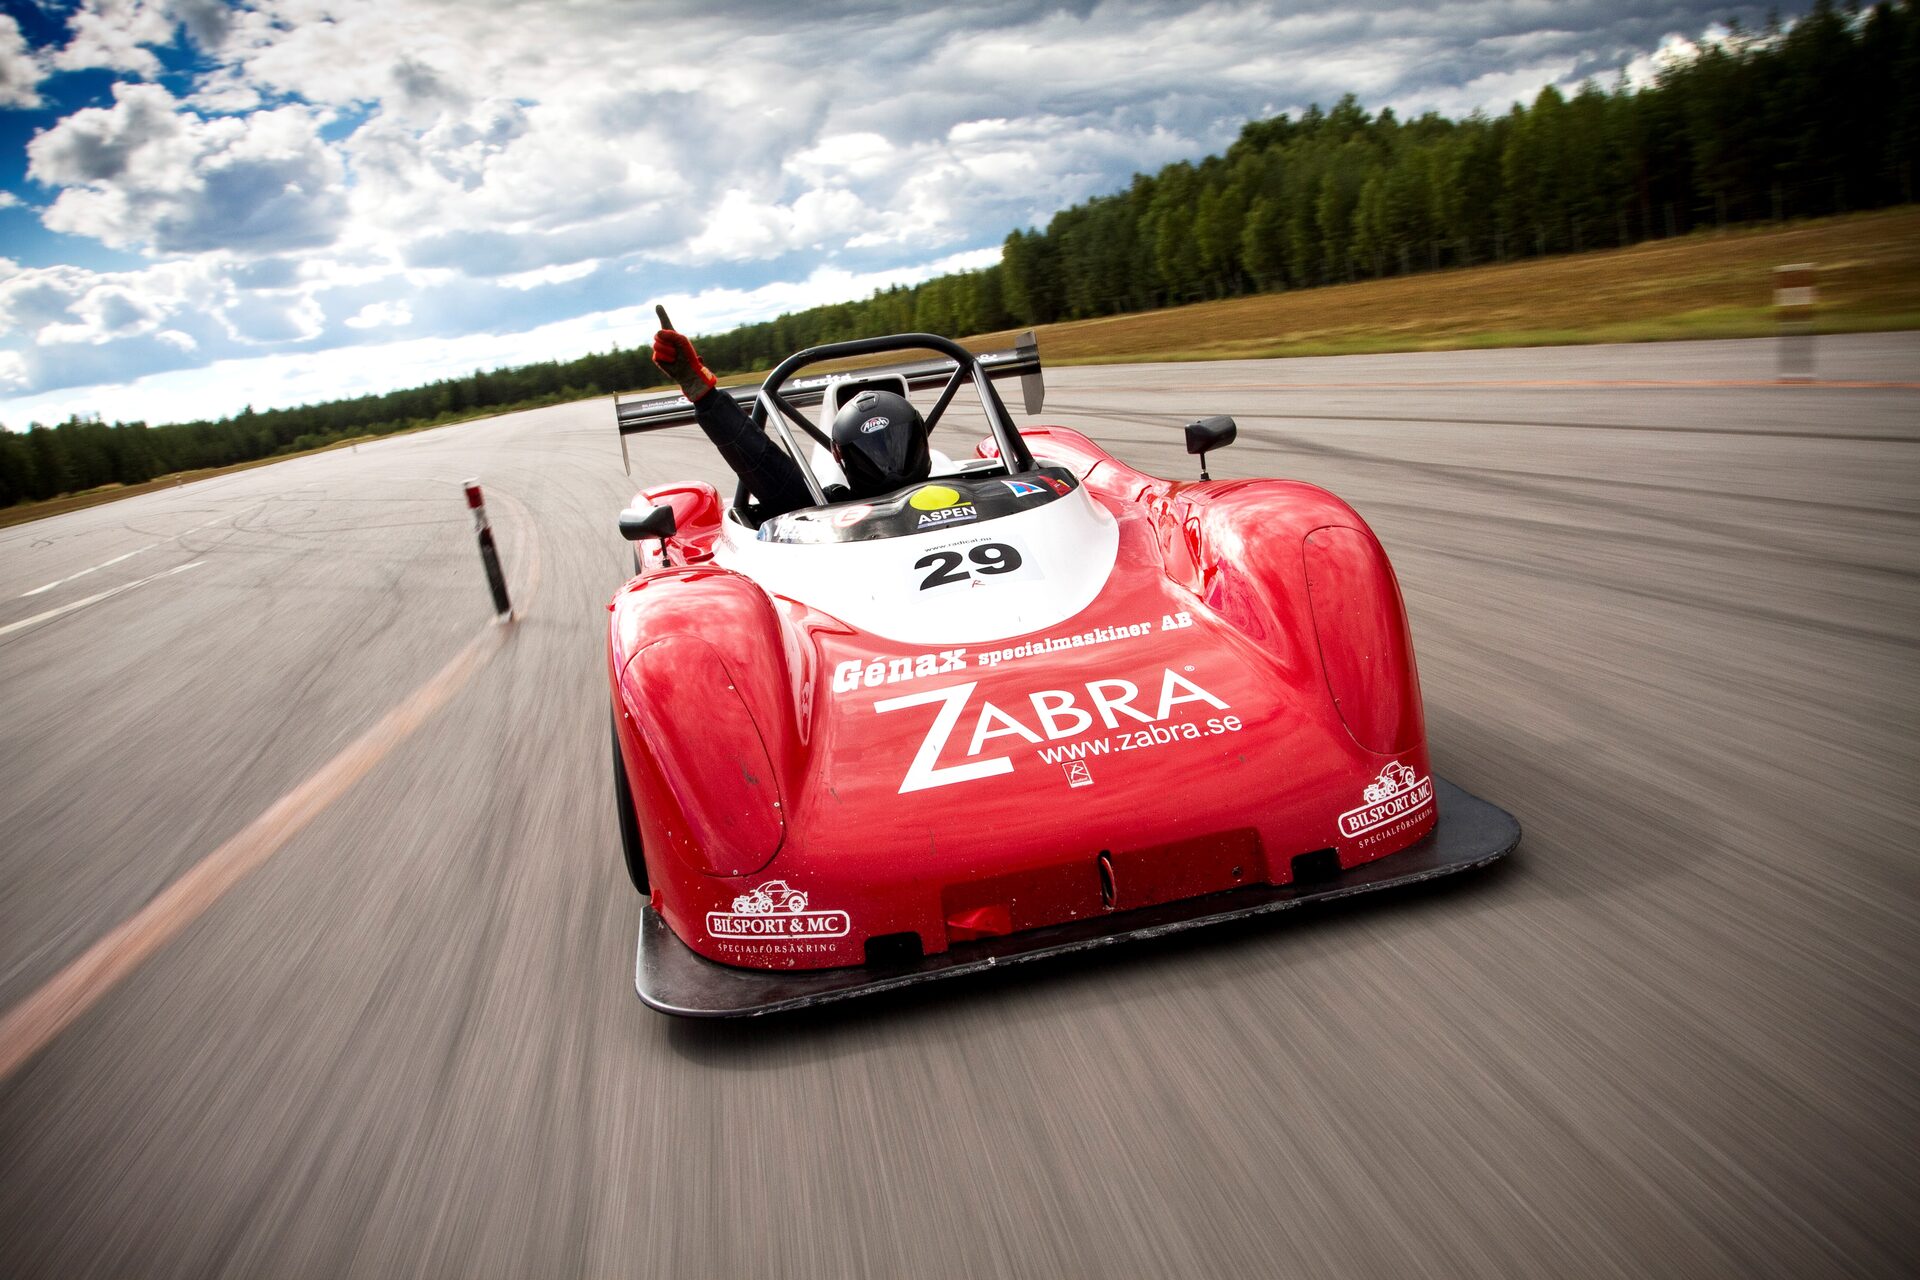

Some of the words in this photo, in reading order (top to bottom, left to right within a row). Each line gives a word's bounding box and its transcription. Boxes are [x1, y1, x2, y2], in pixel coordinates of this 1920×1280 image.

[918, 506, 977, 525] ASPEN
[914, 543, 1022, 591] 29
[832, 648, 967, 693] Génax
[978, 622, 1152, 667] specialmaskiner
[1161, 611, 1194, 632] AB
[1037, 713, 1243, 765] www.zabra.se
[1347, 795, 1410, 831] BILSPORT
[1410, 791, 1419, 804] &
[1418, 782, 1431, 801] MC
[713, 918, 786, 933] BILSPORT
[789, 919, 803, 932] &
[807, 917, 839, 932] MC
[718, 943, 837, 953] SPECIALFÖRSÄKRING
